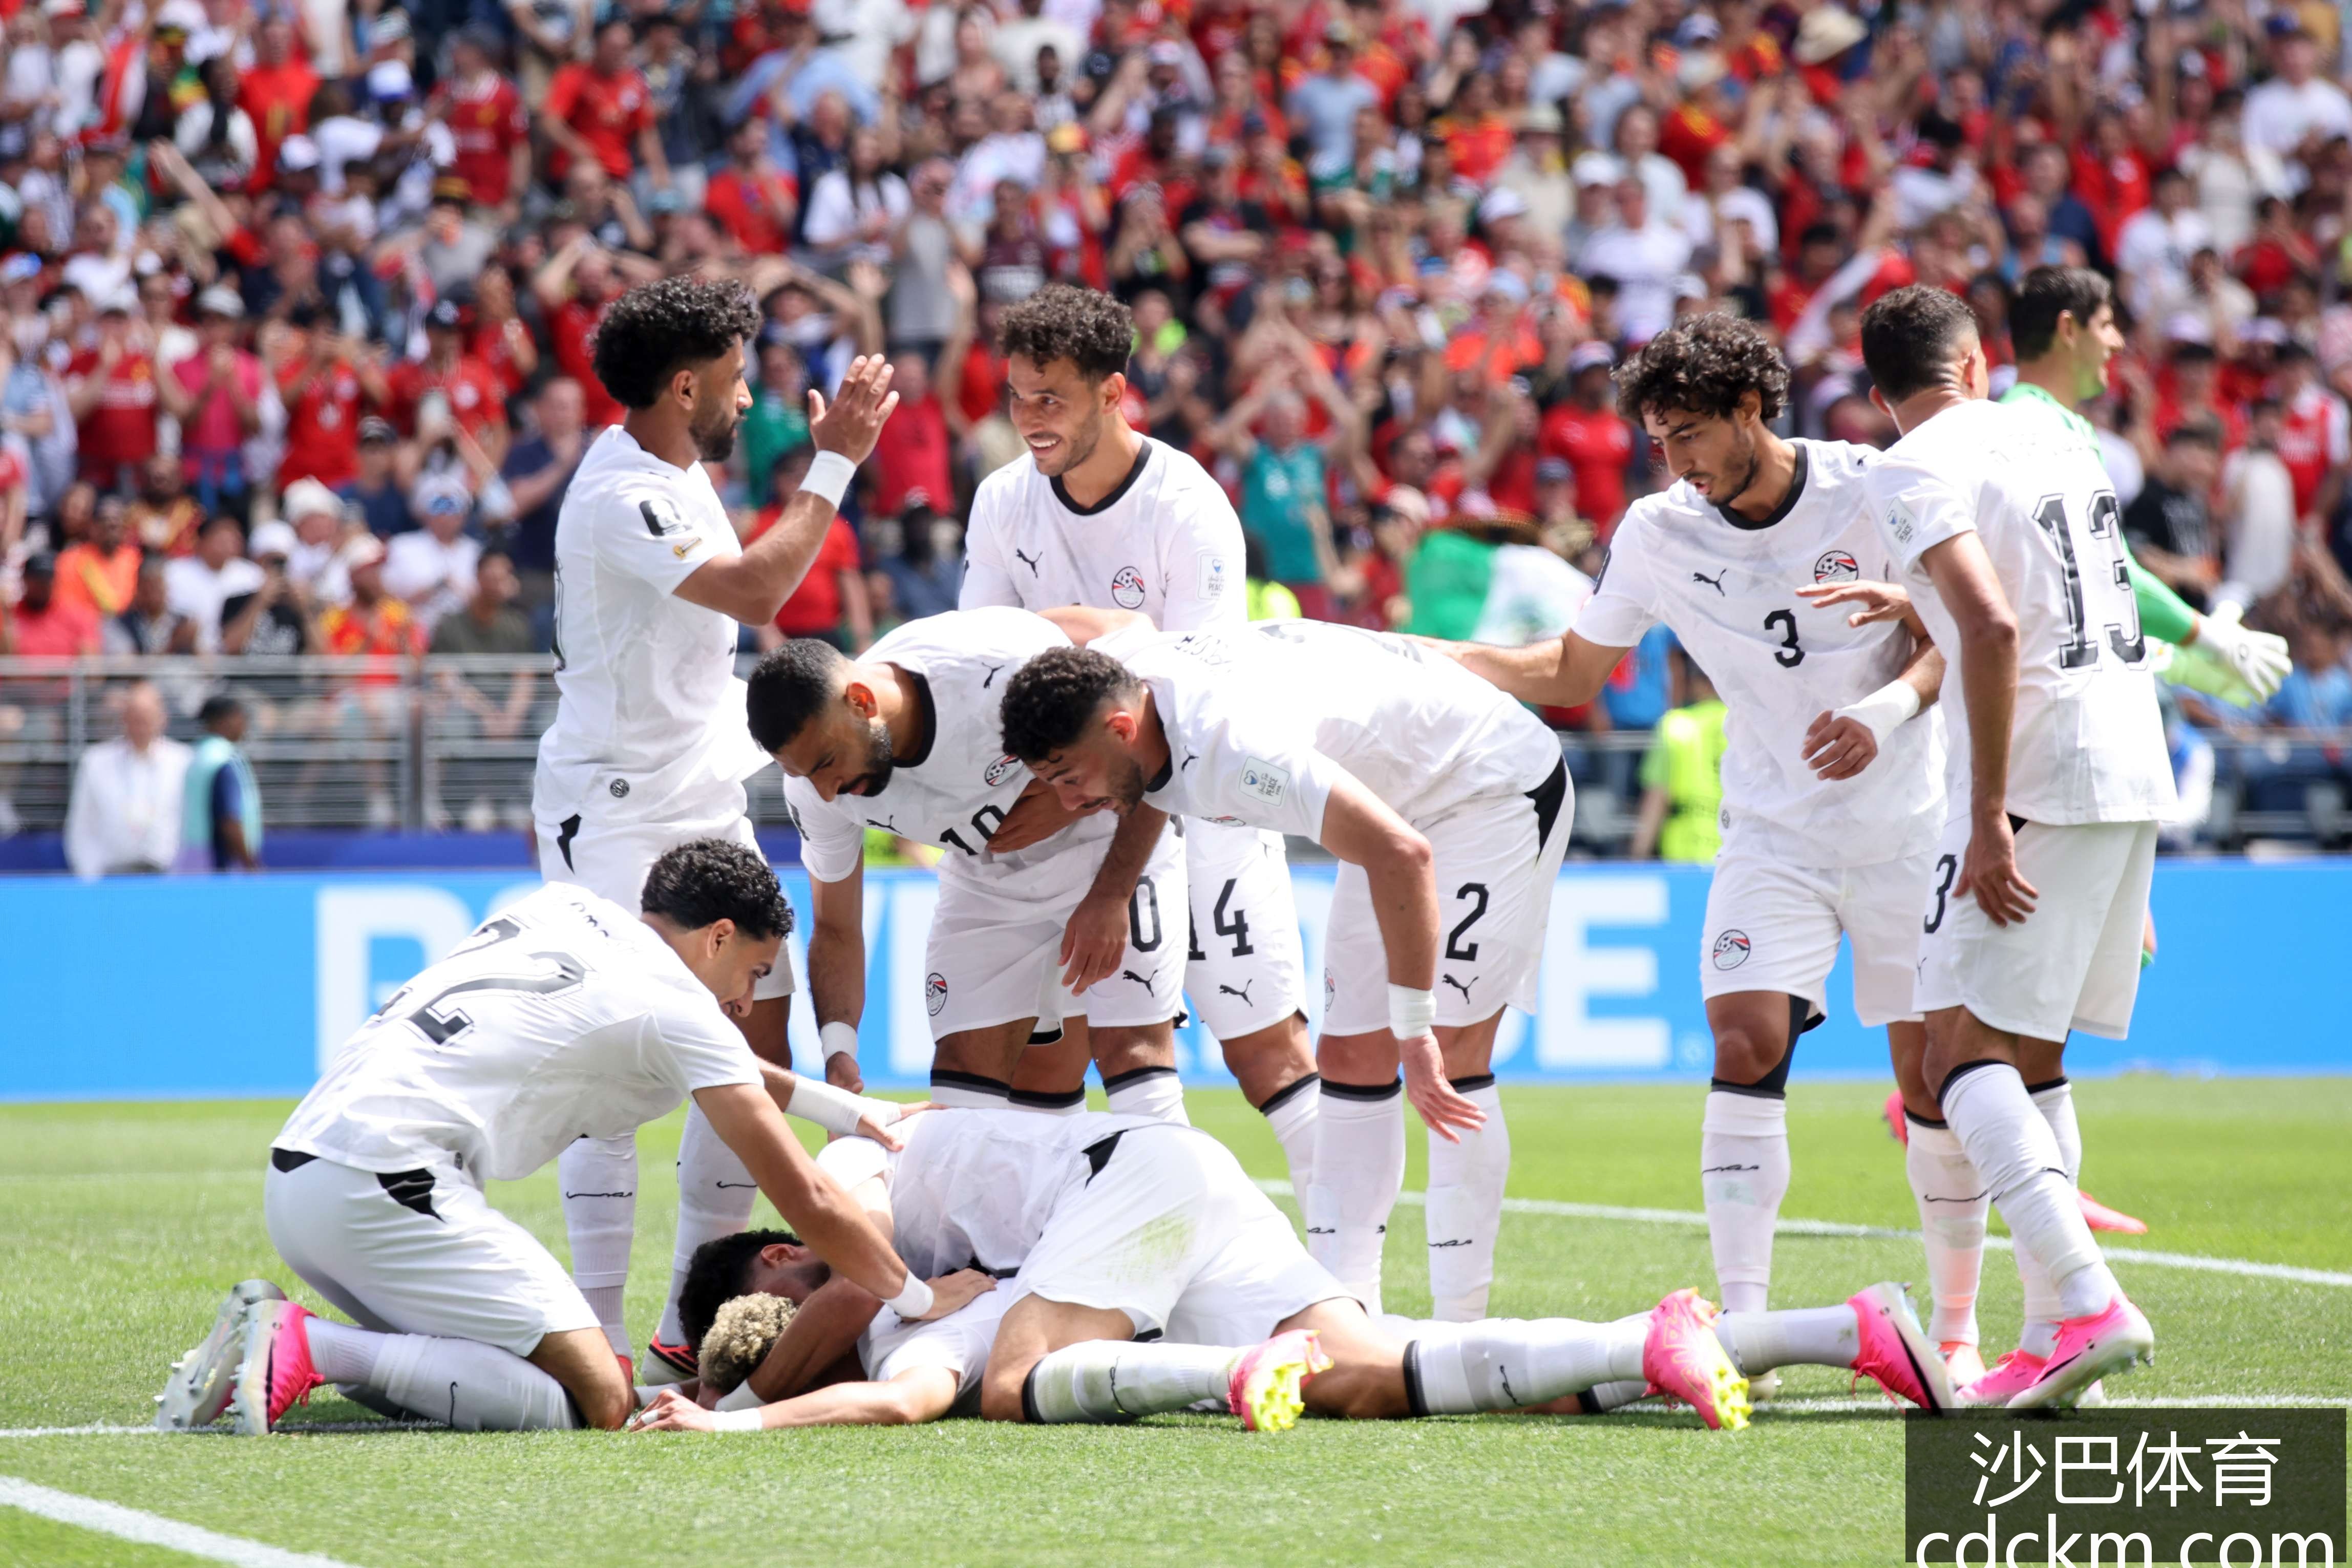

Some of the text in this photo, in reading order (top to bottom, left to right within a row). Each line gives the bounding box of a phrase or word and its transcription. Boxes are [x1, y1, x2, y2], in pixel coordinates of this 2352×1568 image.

[2032, 490, 2150, 675] 13
[1764, 608, 1805, 668] 3
[1266, 776, 1278, 797] PEACE
[939, 803, 1006, 856] 10
[1445, 882, 1489, 962] 2
[370, 914, 596, 1051] 22
